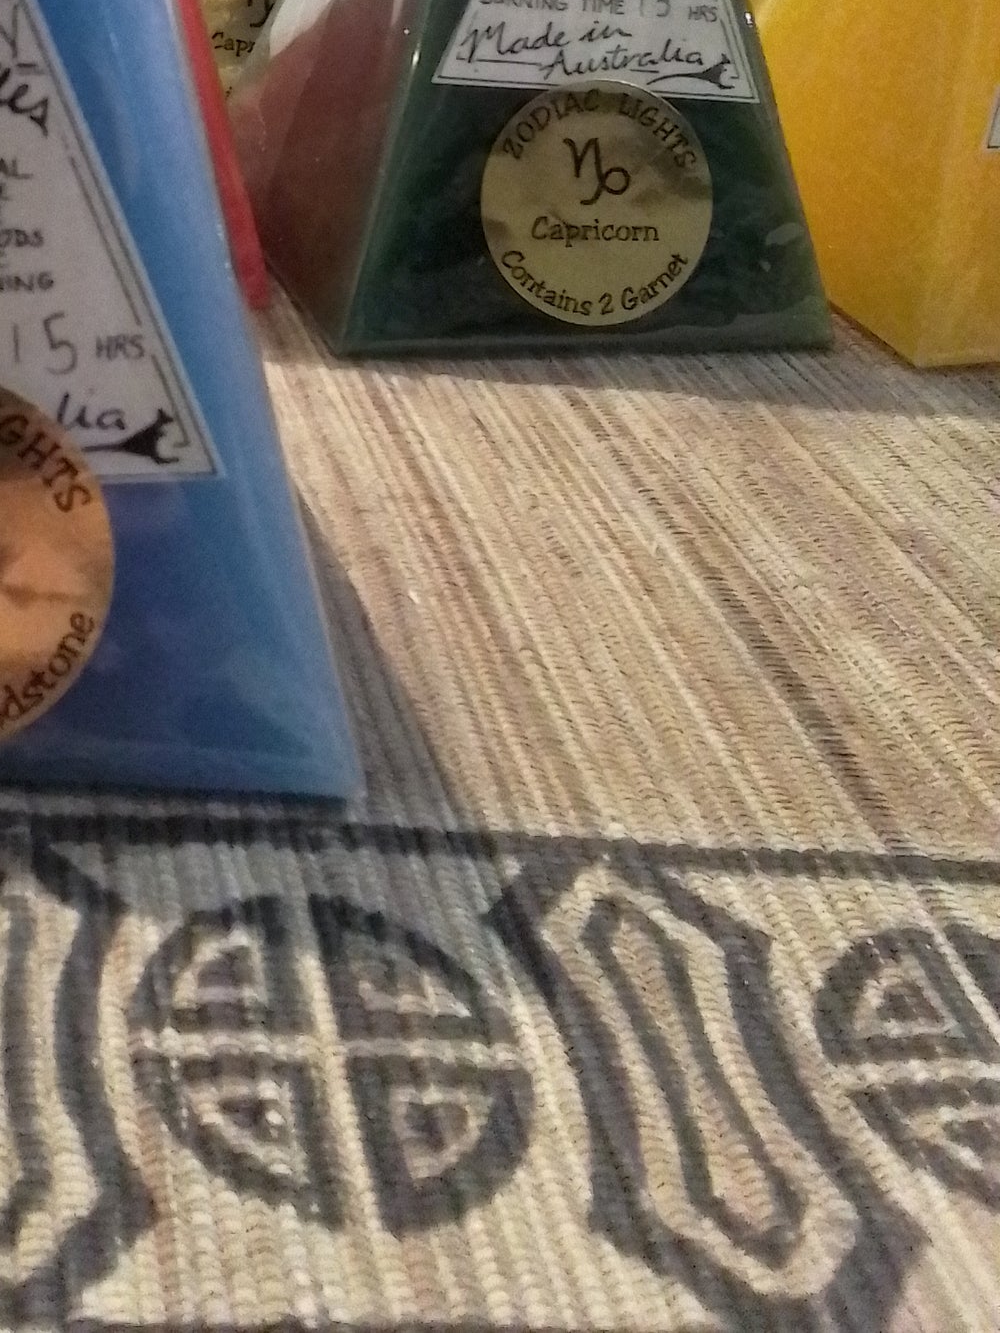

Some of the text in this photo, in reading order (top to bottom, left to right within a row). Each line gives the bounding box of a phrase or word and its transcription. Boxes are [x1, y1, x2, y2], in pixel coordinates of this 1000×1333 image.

[688, 4, 720, 24] HRS
[459, 19, 633, 64] Made in
[537, 37, 705, 81] Australia
[502, 87, 698, 168] ZODIAC LIGHTS
[530, 215, 660, 248] Capricorn
[500, 249, 689, 317] Contains 2 Garnet
[12, 310, 79, 377] 15
[95, 333, 146, 362] HRS
